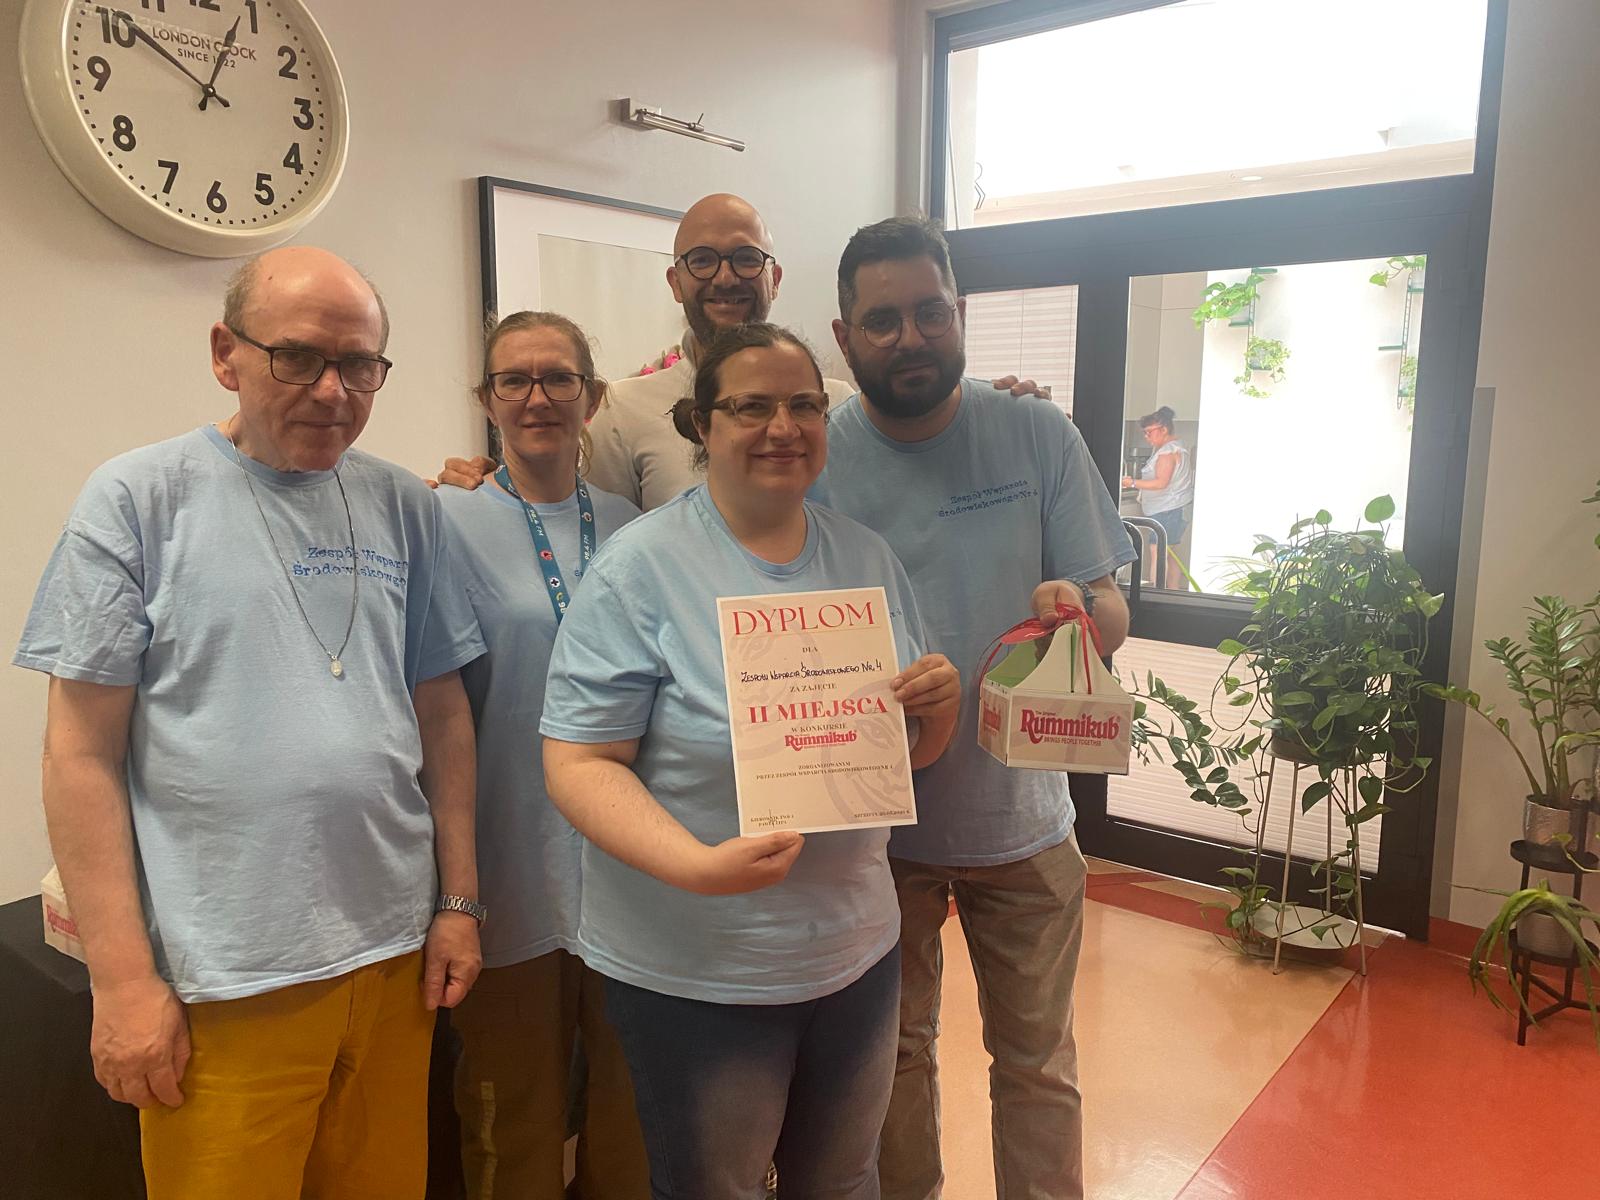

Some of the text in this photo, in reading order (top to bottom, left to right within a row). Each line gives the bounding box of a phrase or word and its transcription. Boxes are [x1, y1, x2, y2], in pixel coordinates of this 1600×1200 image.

[96, 6, 136, 48] 10
[245, 0, 258, 33] 1
[152, 26, 257, 61] LONDON COCK
[177, 48, 236, 68] SINCE 122
[87, 55, 112, 92] 9
[278, 46, 299, 80] 2
[293, 97, 314, 130] 3
[112, 115, 137, 152] 8
[283, 143, 303, 174] 4
[158, 159, 179, 194] 7
[254, 173, 275, 205] 5
[206, 181, 228, 213] 6
[732, 601, 875, 635] DYPLOM
[802, 646, 819, 654] DLA
[876, 658, 883, 671] 4
[789, 685, 800, 693] ZA
[748, 696, 888, 724] II MIEJSCA
[784, 731, 857, 751] Rummikub
[799, 722, 847, 732] KONKURSIE
[1020, 709, 1119, 744] Rummikub
